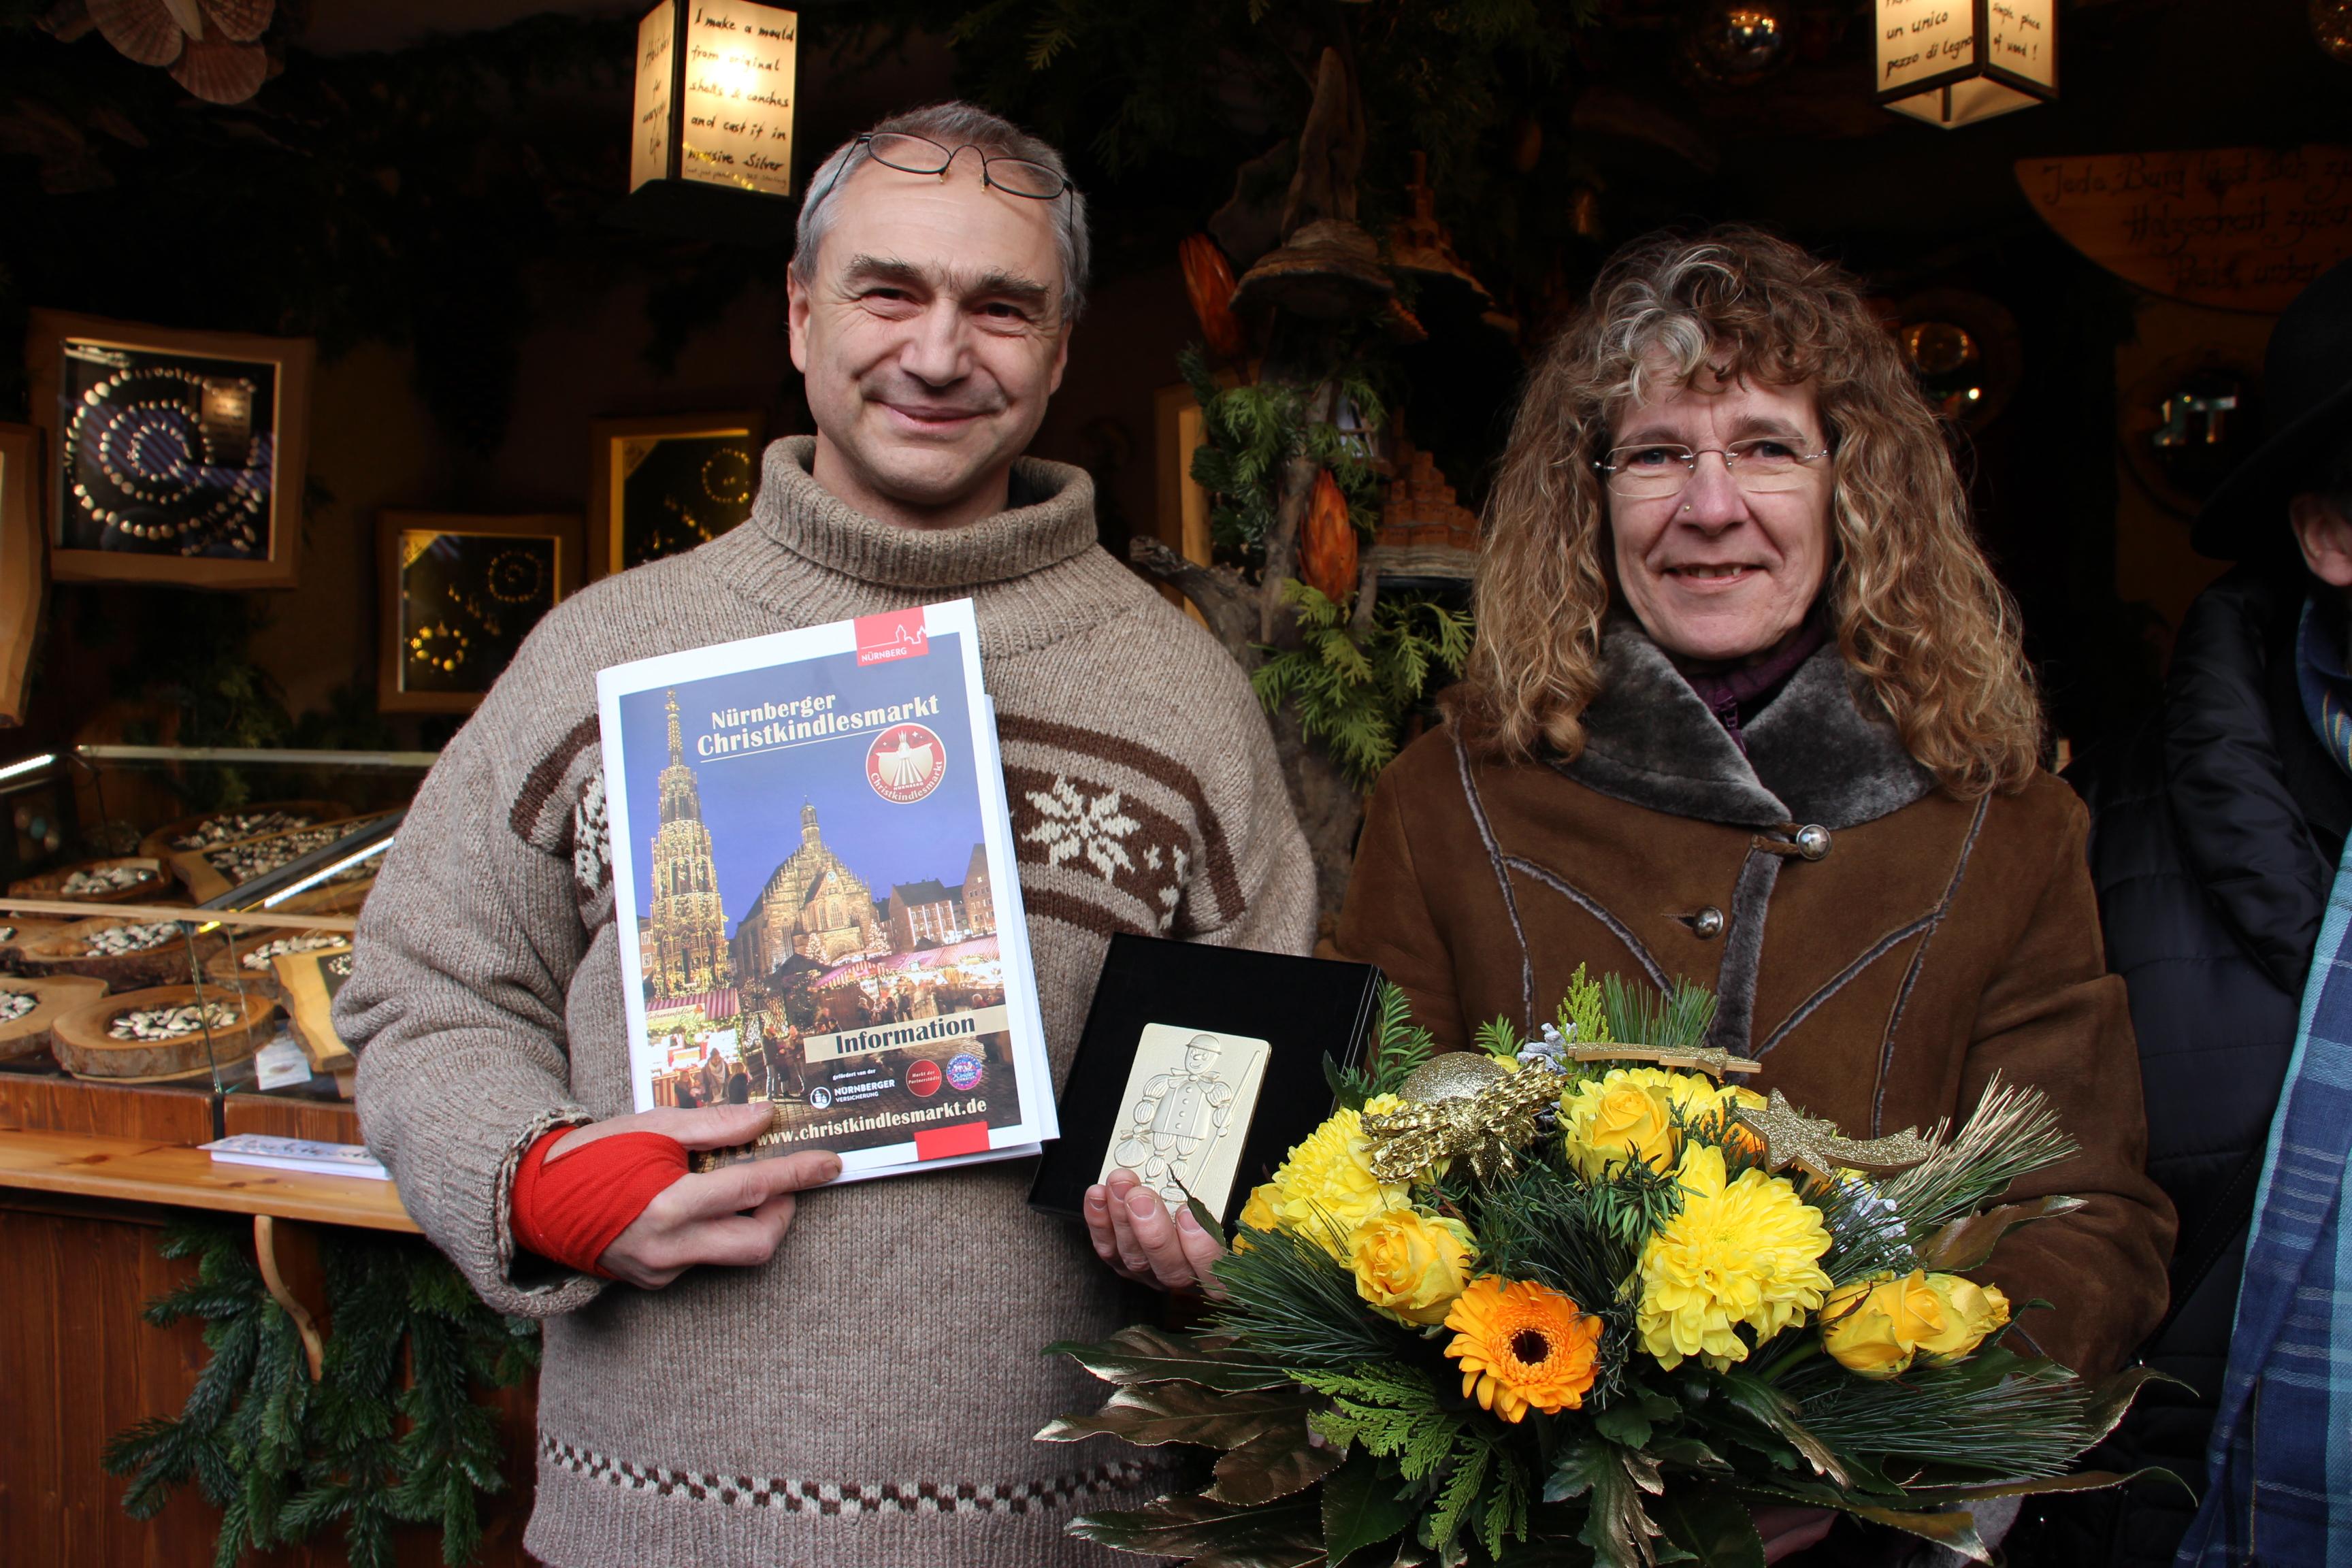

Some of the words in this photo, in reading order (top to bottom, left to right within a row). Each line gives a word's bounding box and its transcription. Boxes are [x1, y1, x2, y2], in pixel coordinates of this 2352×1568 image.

[694, 7, 702, 24] I
[705, 14, 736, 30] make
[745, 25, 752, 33] a
[757, 24, 794, 42] mould
[1886, 27, 1904, 39] un
[1912, 11, 1948, 33] unico
[691, 45, 719, 61] from
[730, 54, 780, 72] original
[1884, 53, 1919, 80] pezzo
[1926, 43, 1939, 59] di
[689, 78, 723, 97] shells
[747, 88, 789, 108] conches
[691, 114, 717, 128] and
[723, 116, 748, 135] cast
[750, 121, 765, 142] it
[770, 127, 786, 140] in
[742, 152, 784, 170] Silver
[861, 647, 907, 662] NÜRNBERG
[697, 694, 940, 756] Christkindlesmarkt
[712, 693, 836, 730] Nürnberger
[870, 761, 943, 801] Christkindlesmarkt
[836, 1015, 976, 1055] Information
[832, 1072, 856, 1081] gefördert
[834, 1079, 896, 1096] NÜRNBERGER
[835, 1091, 879, 1102] VERSICHERUNG
[756, 1098, 987, 1146] www.christkindlesmarkt.de
